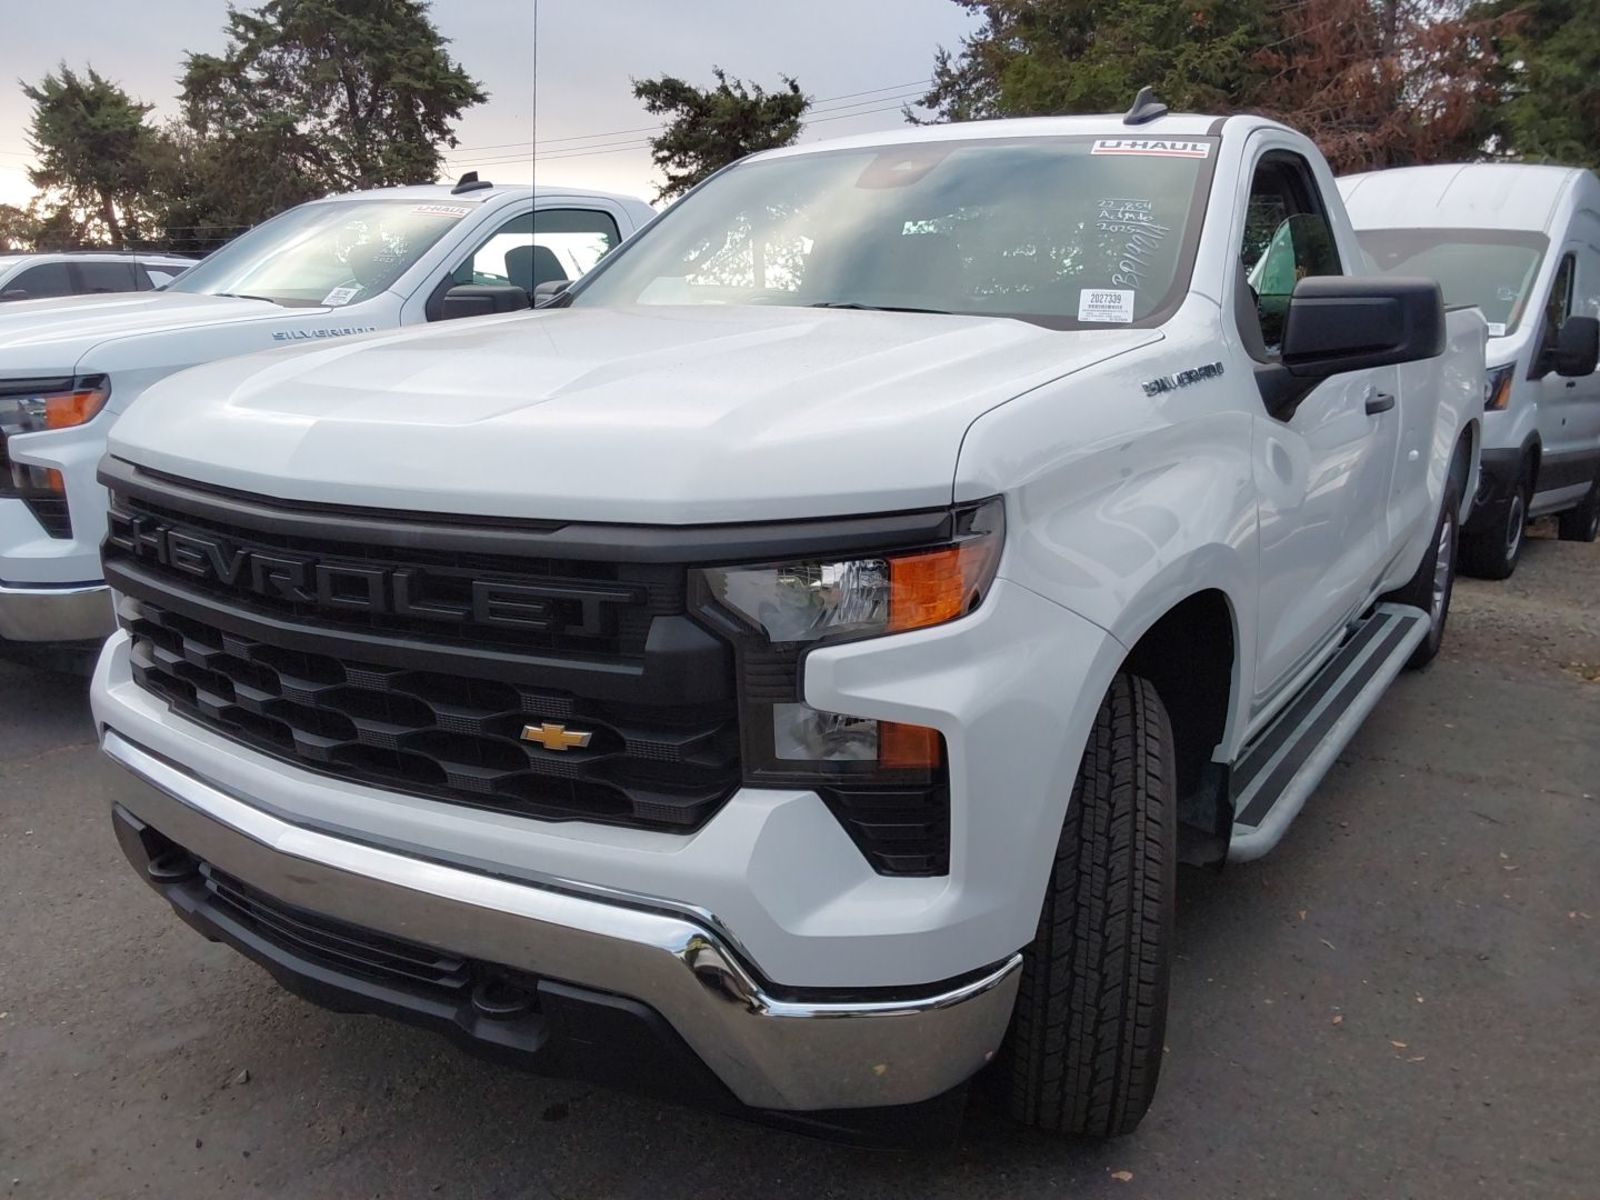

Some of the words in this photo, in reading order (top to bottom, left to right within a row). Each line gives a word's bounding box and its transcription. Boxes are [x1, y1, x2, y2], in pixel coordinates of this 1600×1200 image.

[1100, 141, 1205, 152] U-HAUL
[1097, 222, 1136, 233] 2025
[1090, 293, 1122, 304] 2027339
[107, 509, 635, 635] CHEVROLET
